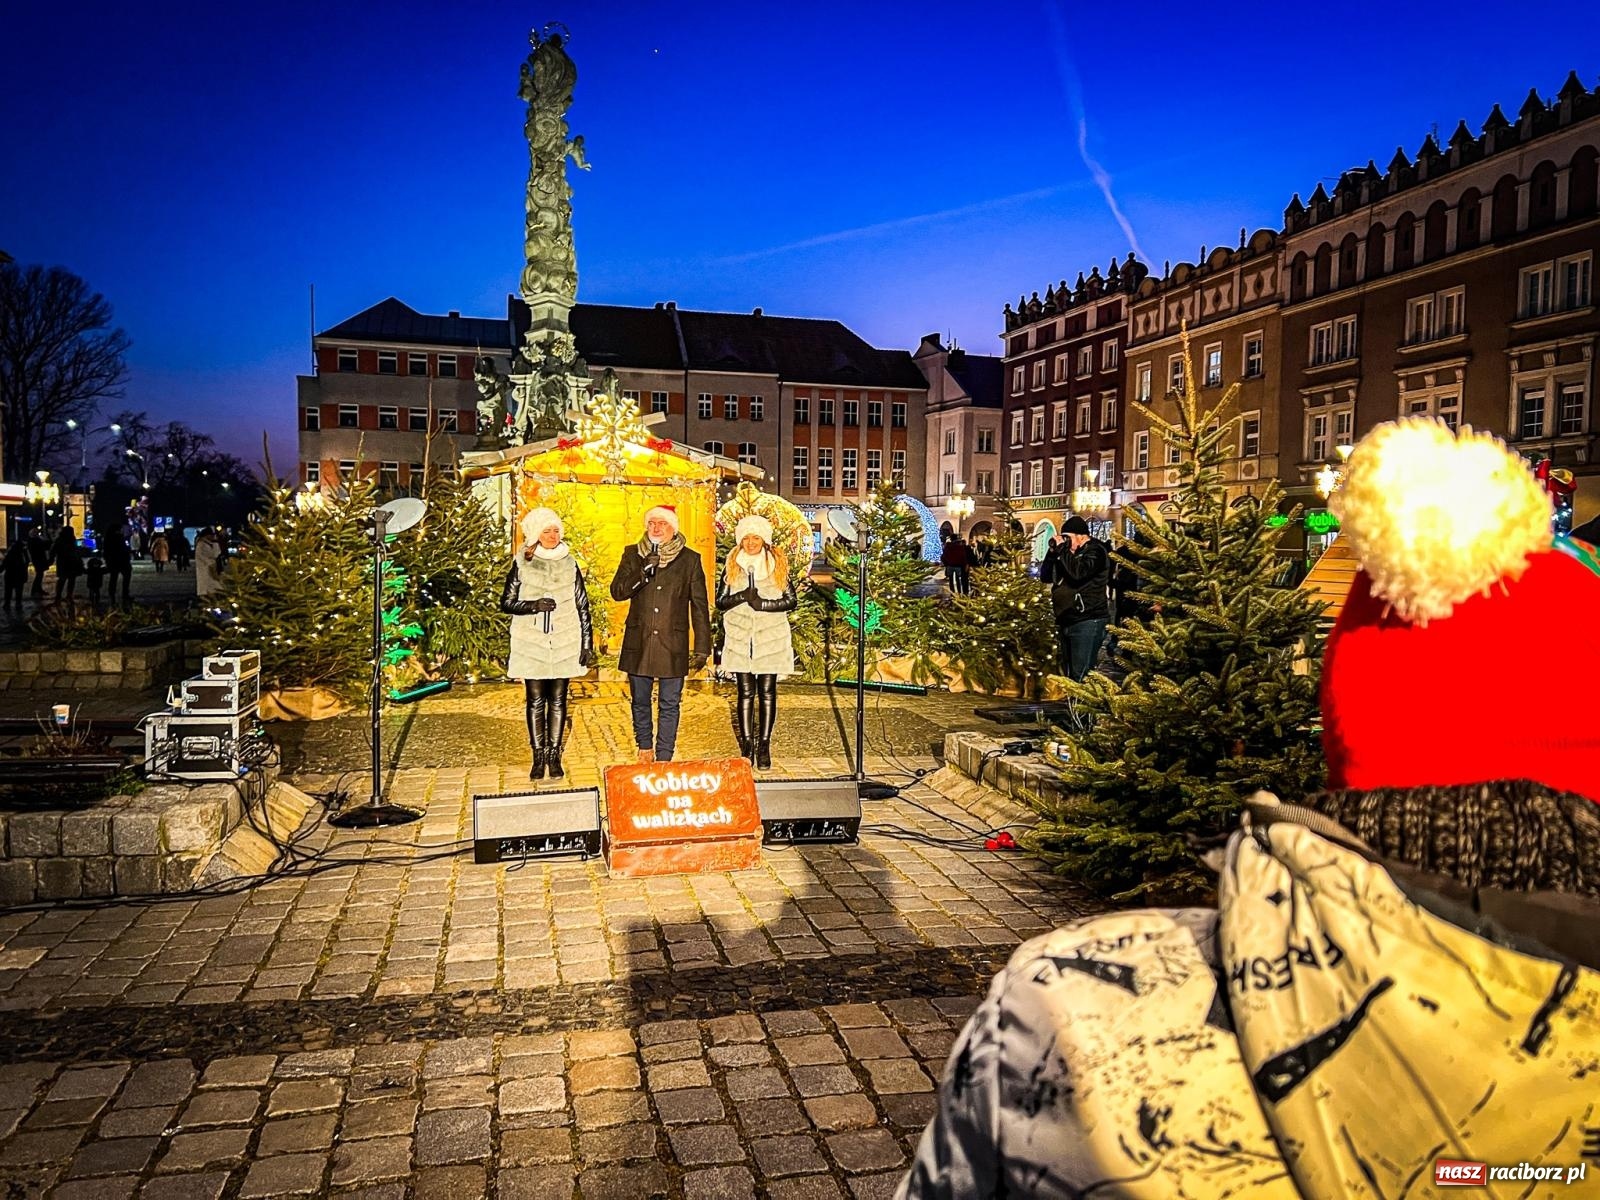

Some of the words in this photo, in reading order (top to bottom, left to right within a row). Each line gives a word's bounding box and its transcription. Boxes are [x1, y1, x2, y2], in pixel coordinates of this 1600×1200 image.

[633, 772, 721, 795] Kobiety
[668, 795, 692, 809] na
[631, 806, 732, 829] walizkach
